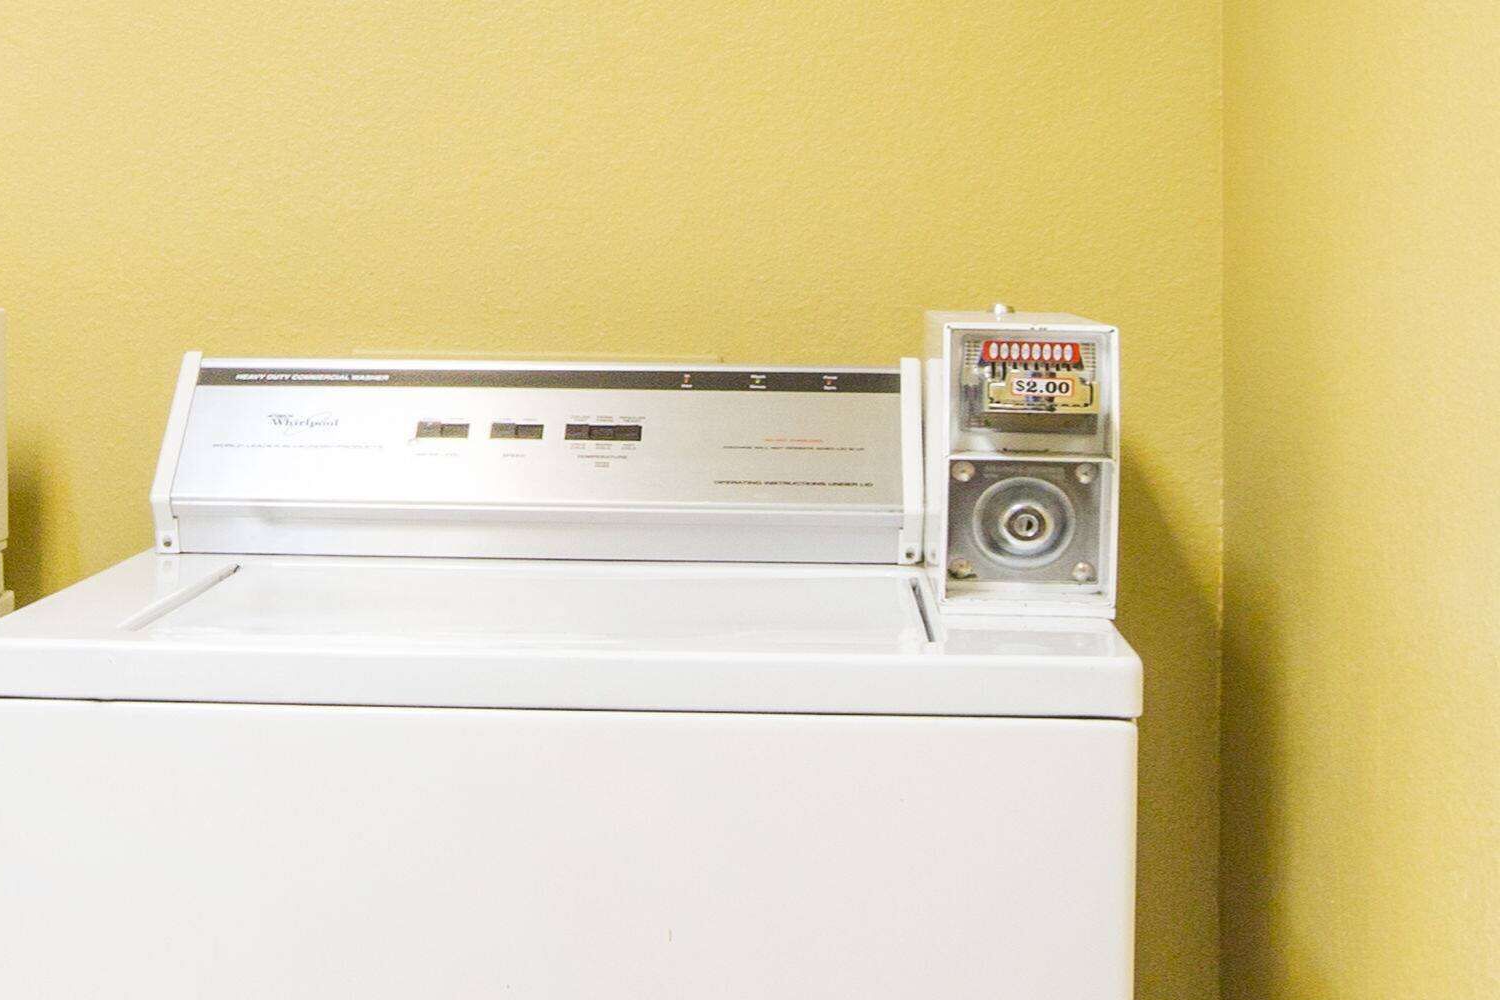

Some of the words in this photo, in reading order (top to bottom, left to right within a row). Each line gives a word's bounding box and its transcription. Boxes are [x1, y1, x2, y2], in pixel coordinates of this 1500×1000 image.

[235, 373, 266, 381] HEAVY
[266, 373, 292, 381] DUTY
[1015, 380, 1070, 394] $2.00
[271, 417, 340, 428] Whirlpool
